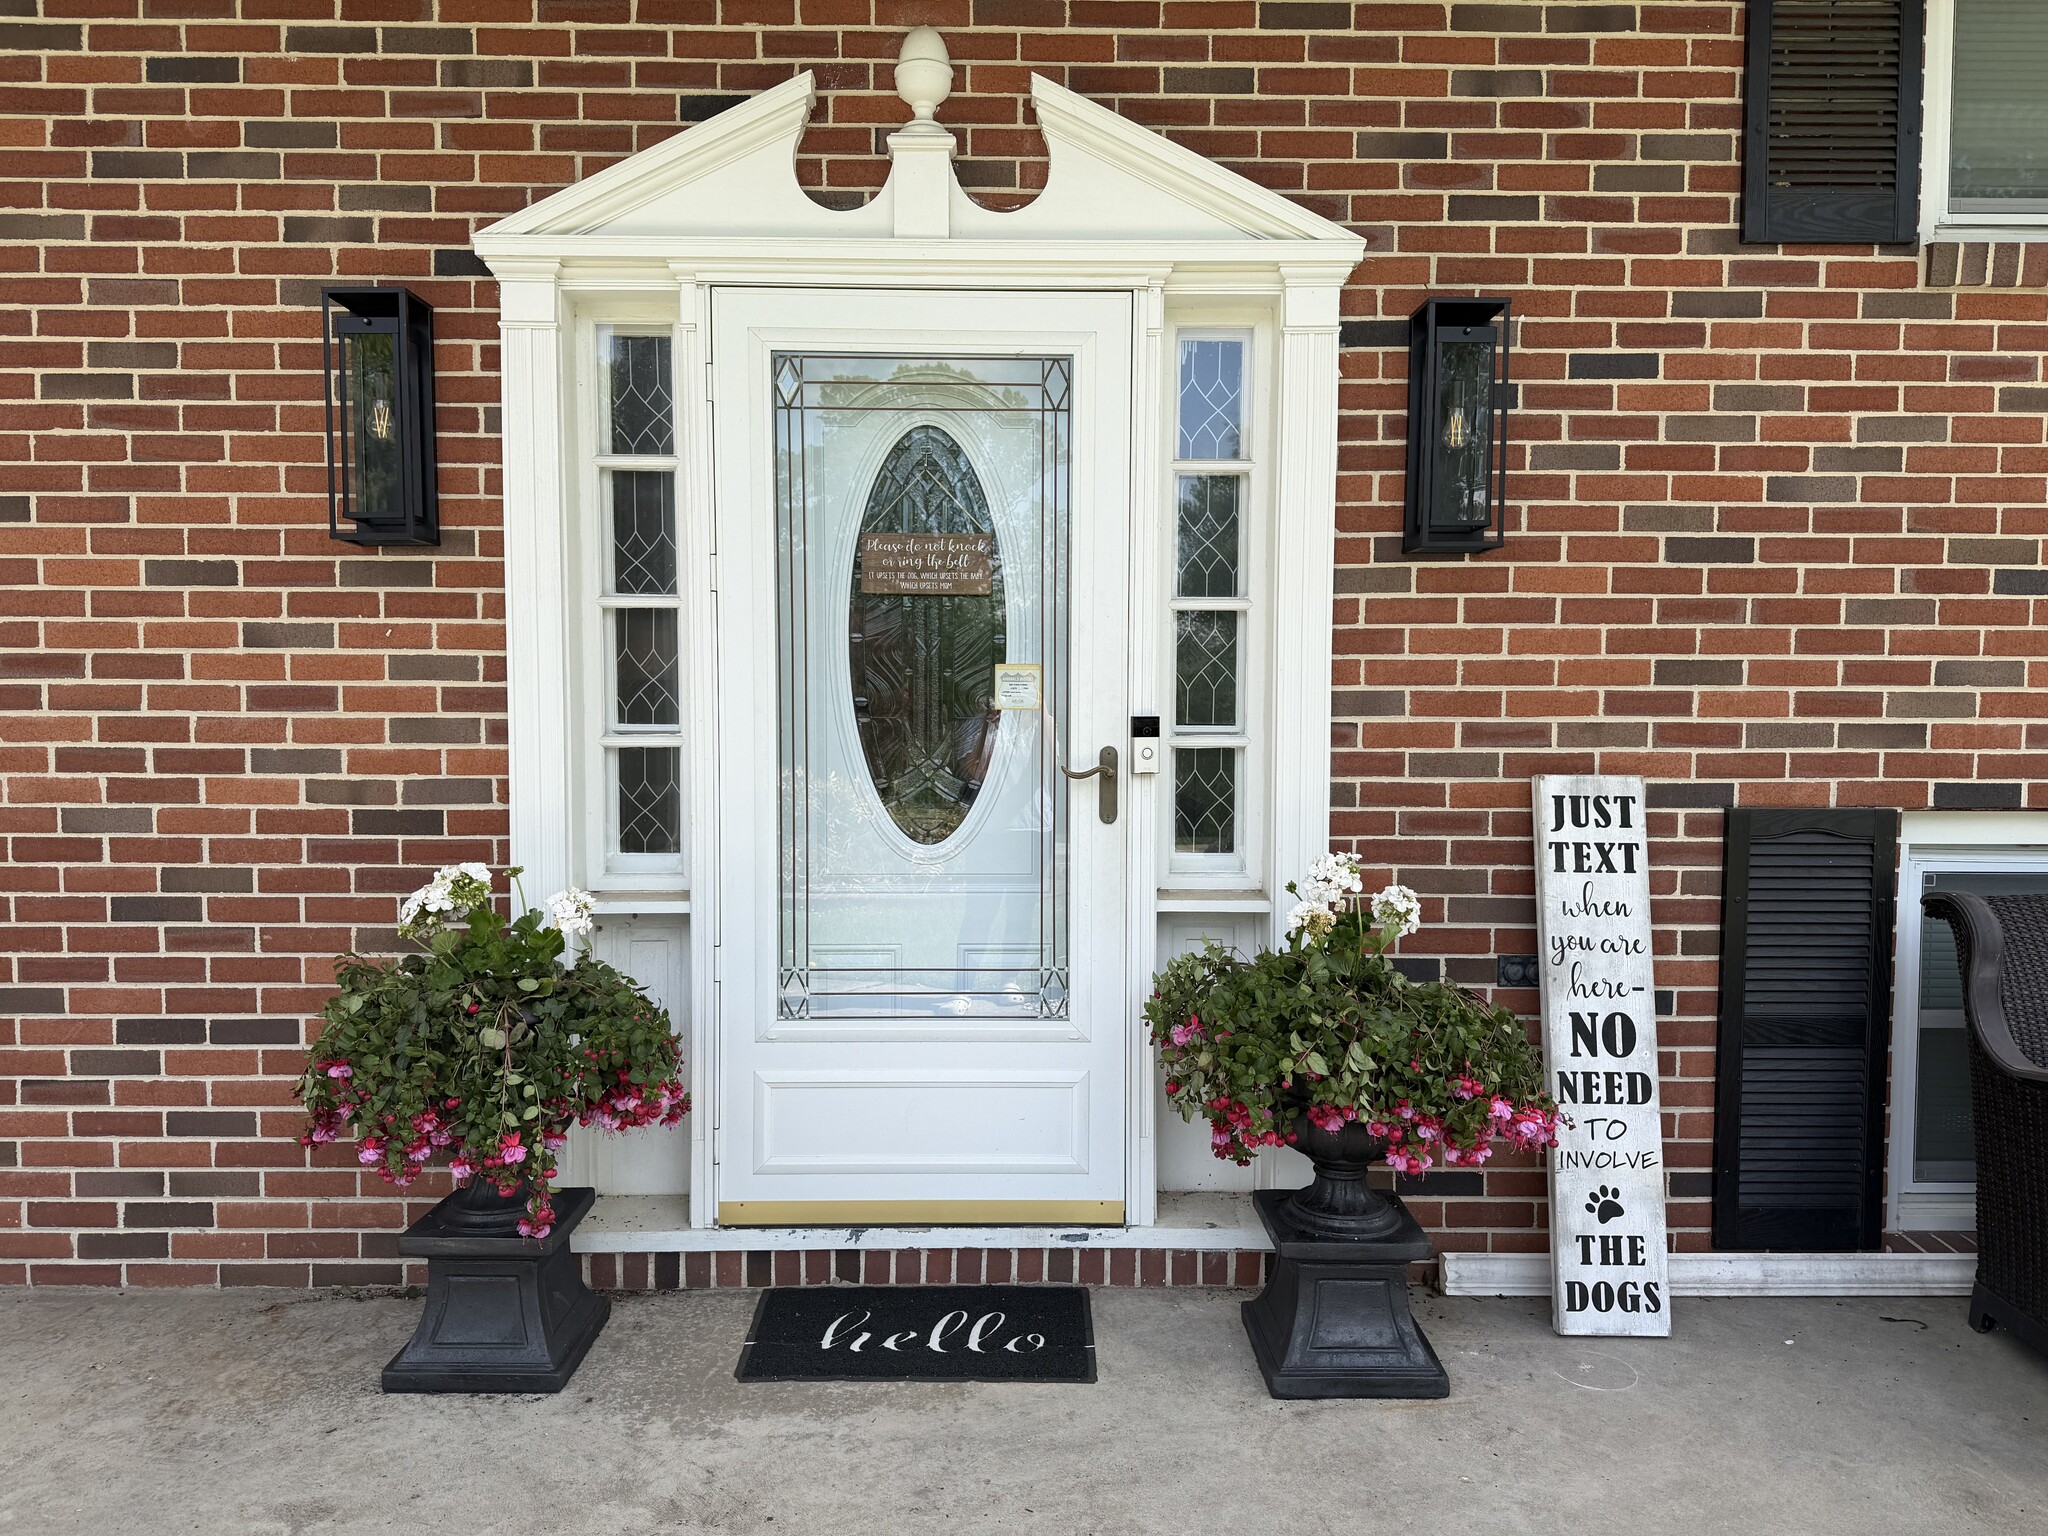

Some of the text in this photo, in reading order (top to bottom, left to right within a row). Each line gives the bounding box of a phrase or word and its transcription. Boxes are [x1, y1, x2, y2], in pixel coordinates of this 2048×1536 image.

[866, 538, 985, 554] Please do not knock
[882, 554, 971, 569] or ring the bell
[876, 571, 895, 580] UPSETS
[897, 571, 905, 580] THE
[920, 571, 937, 580] WHICH
[939, 571, 958, 580] UPSETS
[960, 571, 969, 580] THE
[900, 581, 953, 590] WHICH UPSETS MOM
[1550, 795, 1636, 832] JUST
[1548, 841, 1639, 874] TEXT
[1562, 881, 1633, 918] when
[1551, 935, 1646, 966] you are
[1568, 1011, 1637, 1058] NO
[1556, 1071, 1653, 1105] NEED
[1583, 1118, 1627, 1141] TO
[1559, 1150, 1659, 1170] INVOLVE
[1575, 1235, 1646, 1266] THE
[1565, 1280, 1661, 1314] DOGS
[818, 1310, 1046, 1353] hello
